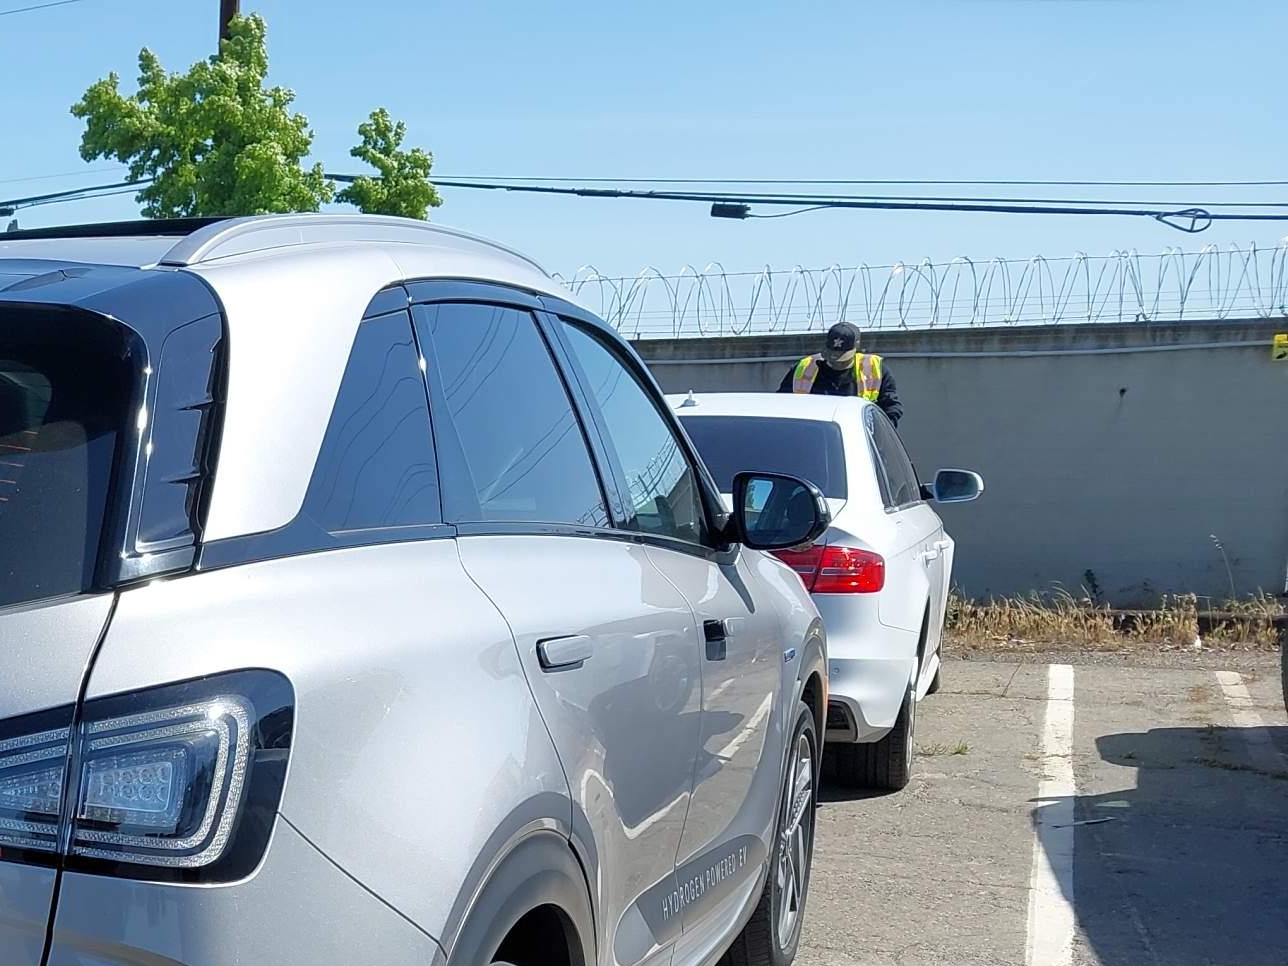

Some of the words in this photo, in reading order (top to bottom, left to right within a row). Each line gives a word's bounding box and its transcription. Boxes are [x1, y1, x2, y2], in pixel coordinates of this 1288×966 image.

[662, 874, 705, 920] HYDROGEN
[706, 853, 736, 889] POWERED
[739, 845, 748, 868] EV
